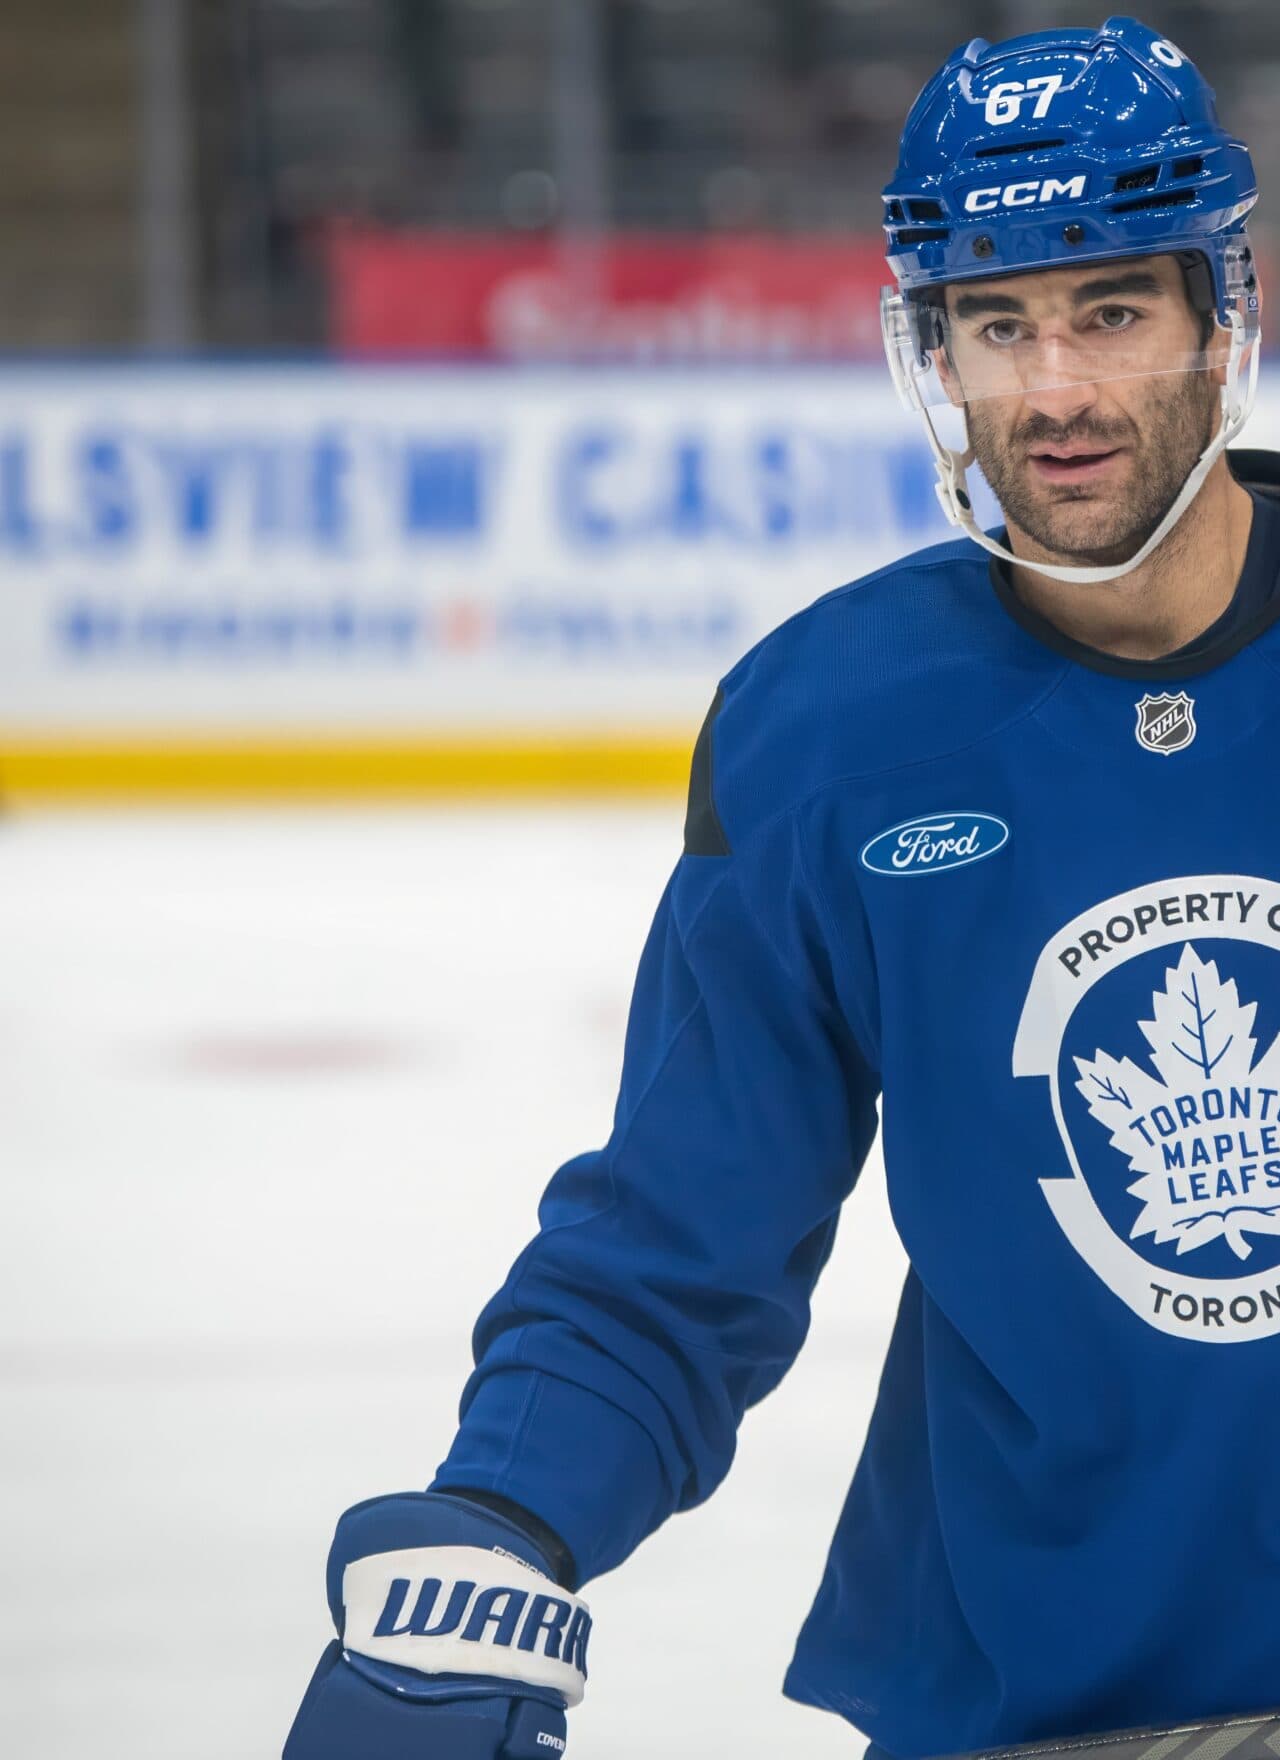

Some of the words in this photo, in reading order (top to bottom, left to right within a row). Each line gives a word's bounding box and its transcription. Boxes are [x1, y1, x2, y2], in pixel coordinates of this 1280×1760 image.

[984, 74, 1064, 126] 67
[963, 175, 1088, 214] CCM
[1149, 707, 1184, 742] NHL
[891, 821, 981, 870] Ford
[1058, 890, 1260, 979] PROPERTY
